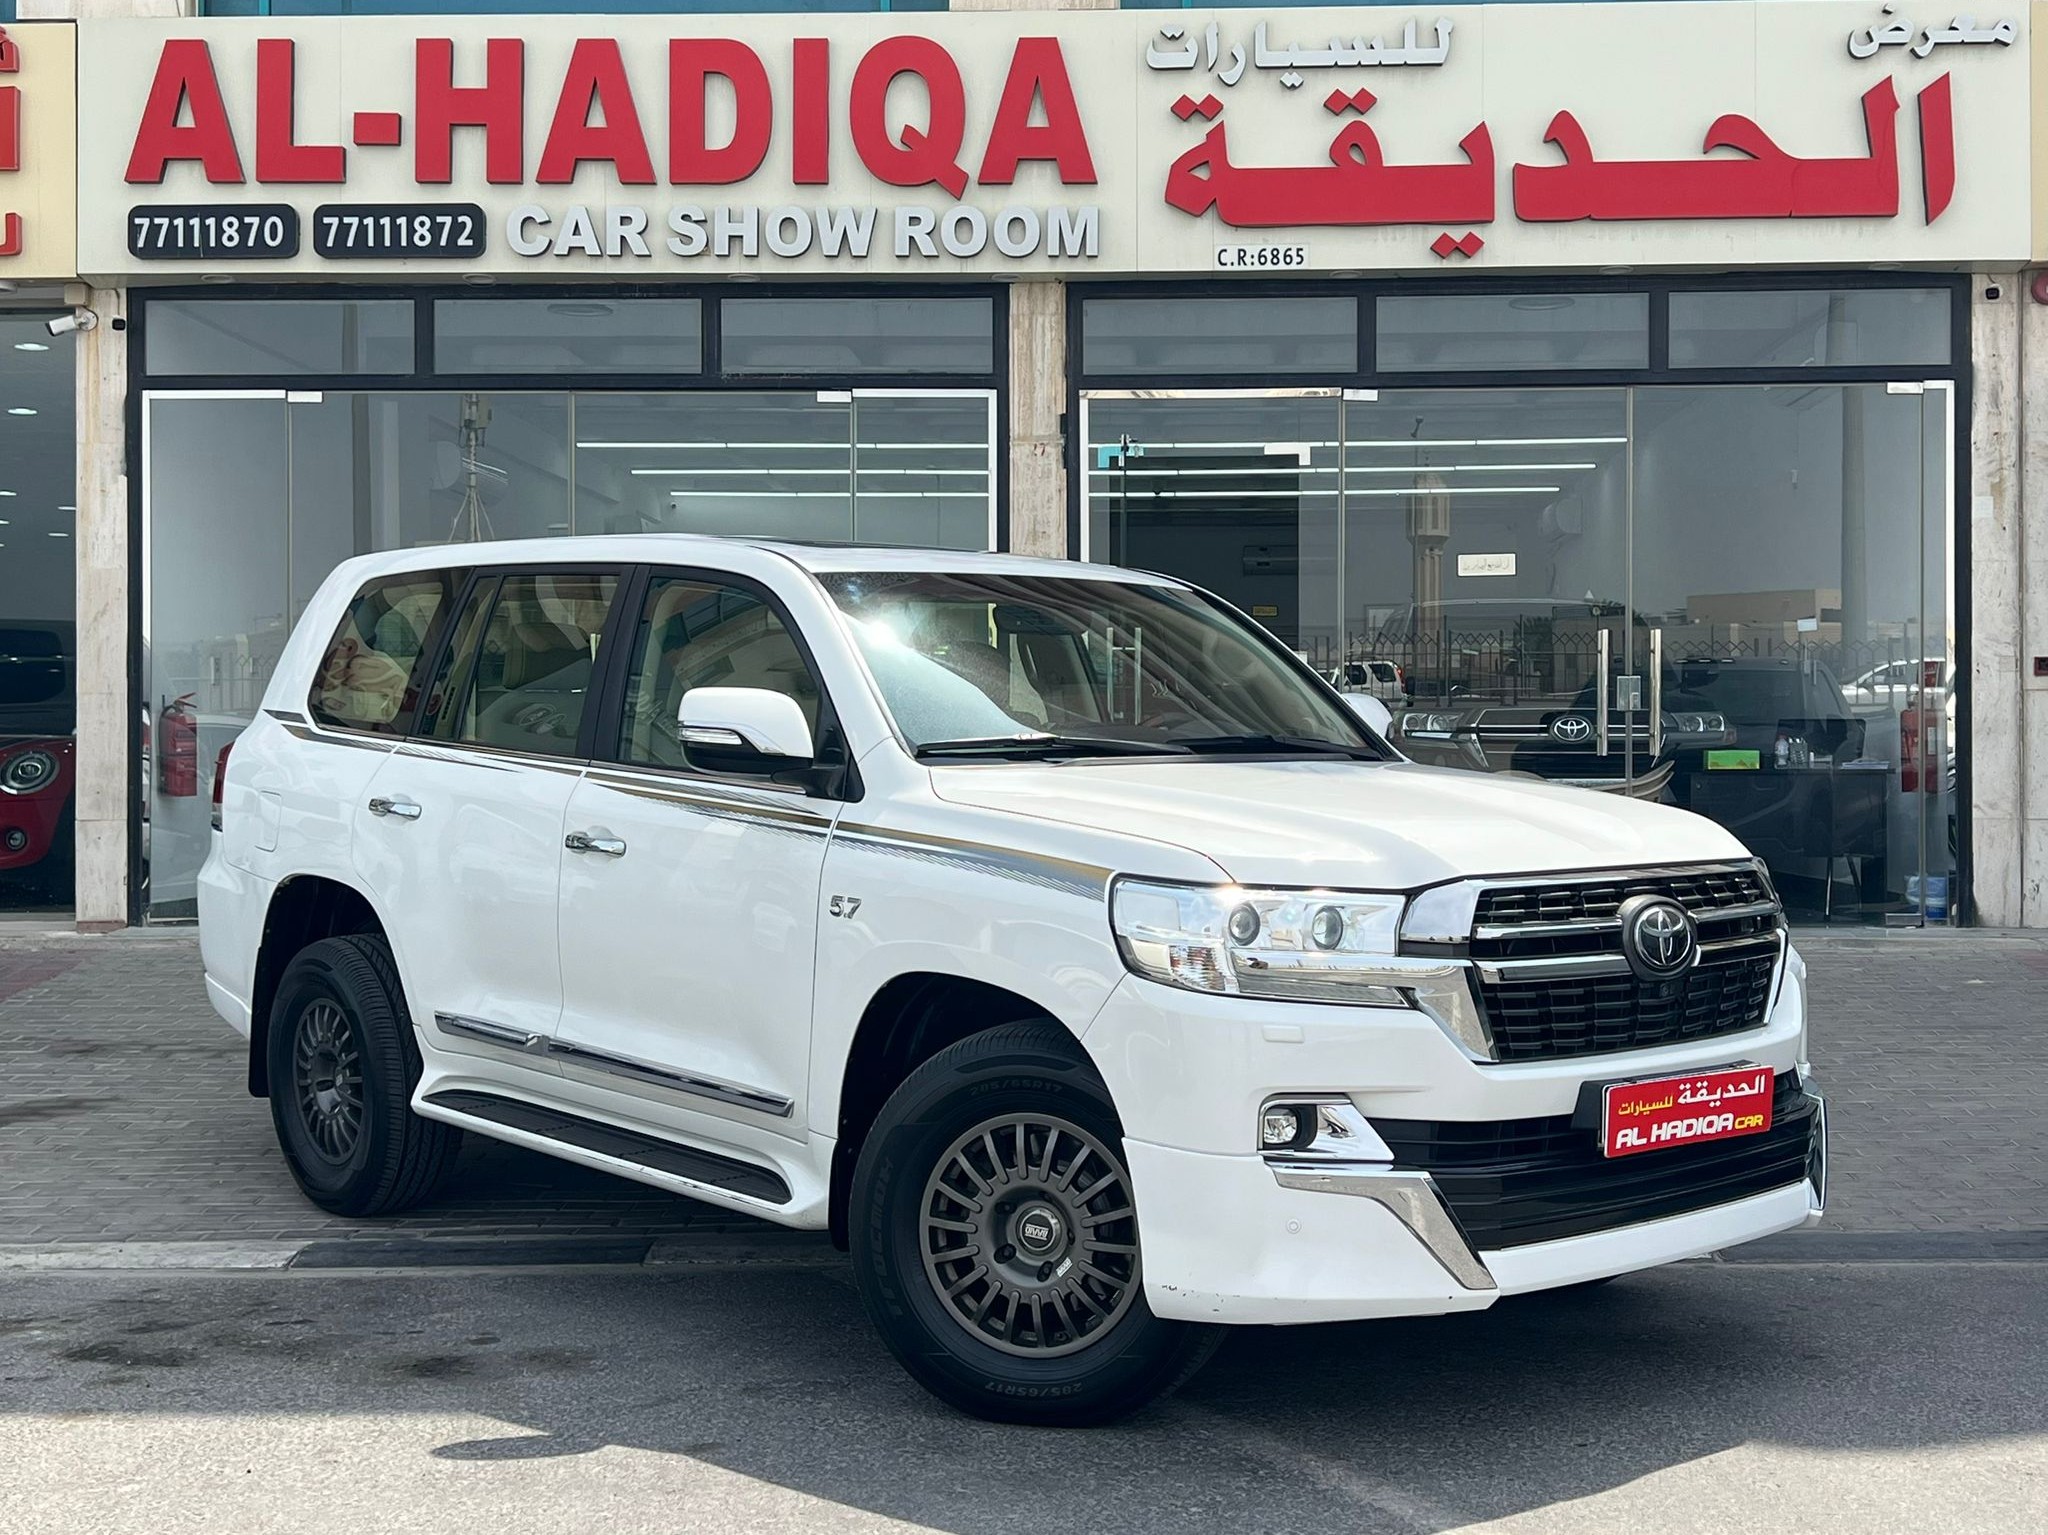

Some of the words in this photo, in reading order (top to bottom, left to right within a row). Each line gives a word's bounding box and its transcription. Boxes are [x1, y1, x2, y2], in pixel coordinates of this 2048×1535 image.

[1847, 3, 2018, 60] معرض
[1146, 16, 1454, 87] للسيارات
[124, 36, 1098, 200] AL-HADIQA
[1164, 71, 1955, 260] الحديقة
[134, 215, 284, 249] 77111870
[321, 215, 474, 248] 77111872
[506, 205, 651, 258] CAR
[667, 205, 877, 258] SHOW
[895, 205, 1099, 258] ROOM
[1217, 247, 1305, 268] C.R:6865
[1618, 1095, 1674, 1117] للسيارات
[1677, 1074, 1766, 1108] الحديقة
[1615, 1128, 1648, 1150] AL
[1650, 1113, 1736, 1144] HADIQA
[1734, 1114, 1764, 1130] CAR
